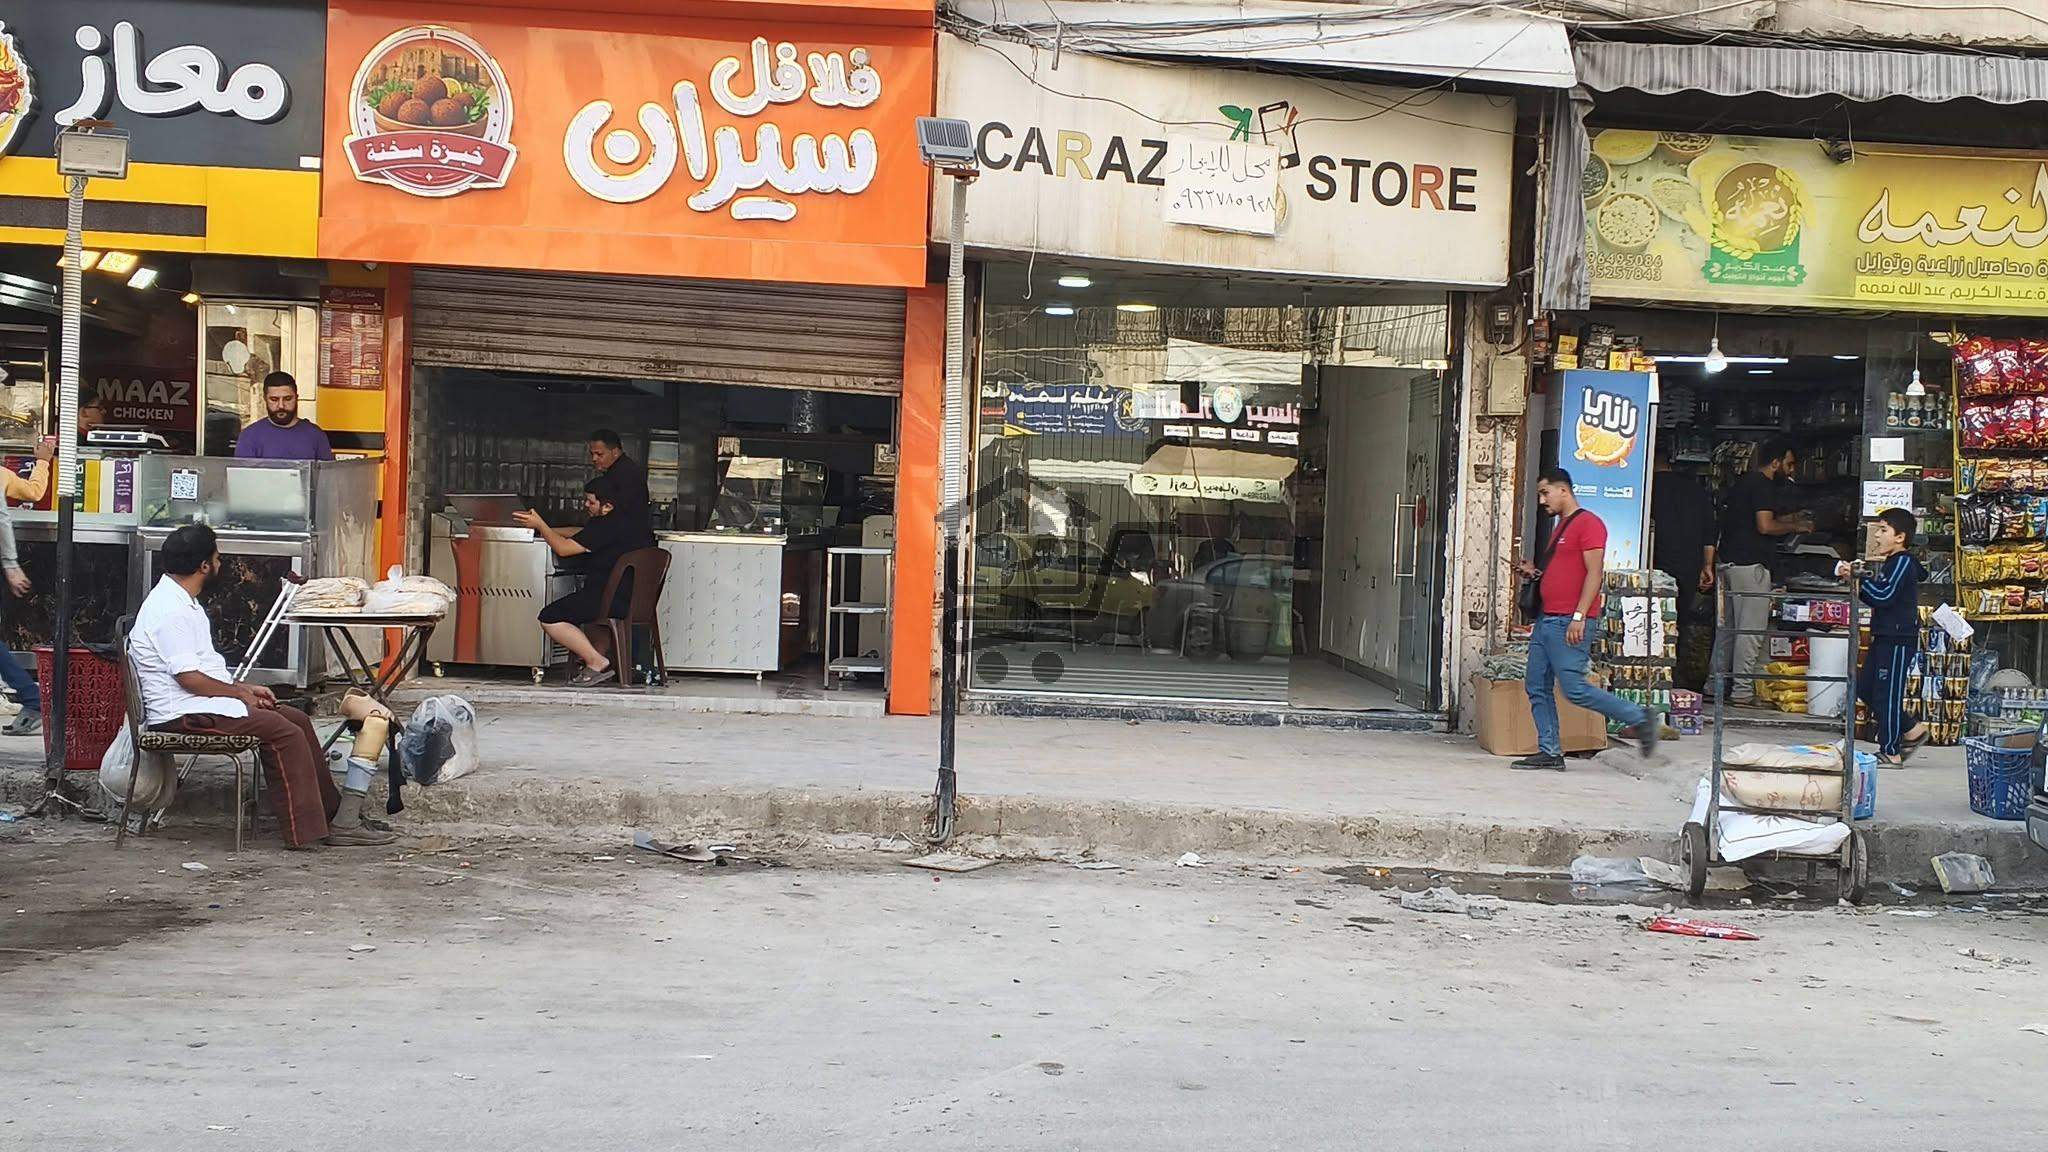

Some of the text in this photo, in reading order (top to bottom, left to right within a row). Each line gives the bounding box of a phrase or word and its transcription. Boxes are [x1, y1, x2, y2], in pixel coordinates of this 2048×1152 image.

[54, 21, 285, 126] معاز
[709, 36, 882, 117] فلافل
[366, 139, 484, 166] خبزة سخنة
[563, 79, 879, 221] سيران
[1232, 145, 1271, 183] محل
[976, 121, 1478, 212] CARAZ STORE
[1857, 161, 2048, 248] لنعمه
[1856, 251, 1913, 276] وتوابل
[1916, 253, 1966, 277] زراعية
[1967, 256, 2035, 279] محاصيل
[1898, 282, 1921, 296] الله
[1950, 285, 2001, 300] الكريم
[97, 378, 190, 406] MAAZ
[113, 407, 174, 420] CHICKEN
[1583, 387, 1638, 435] راني
